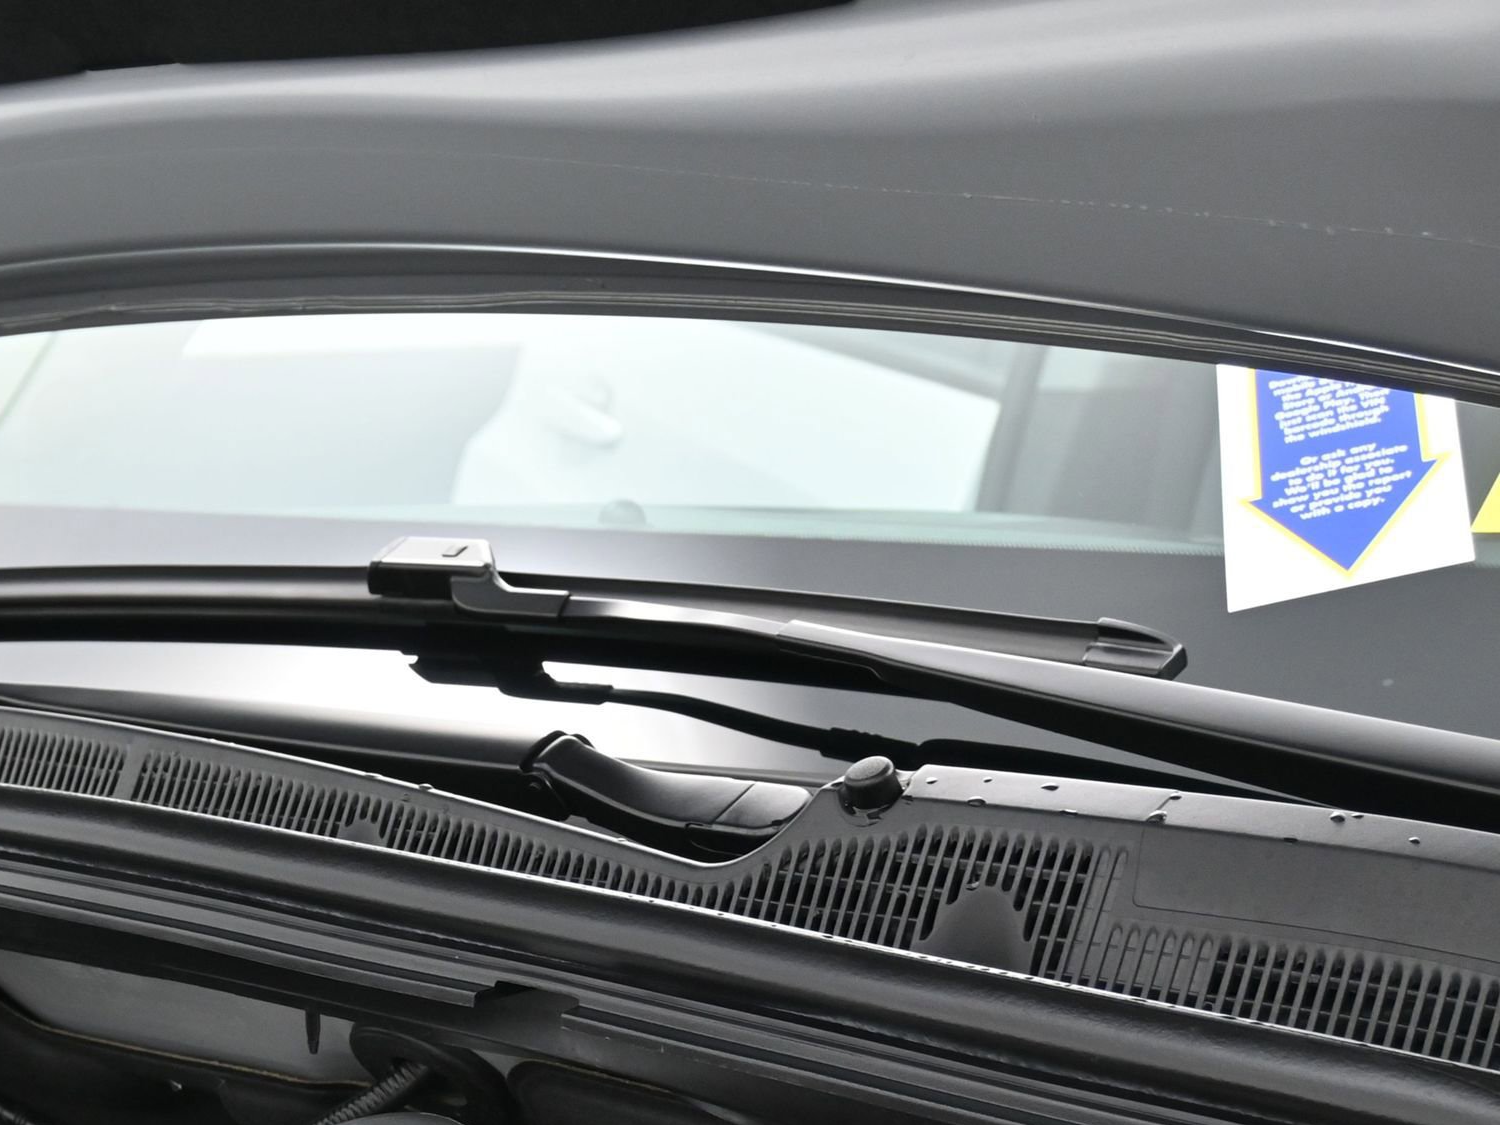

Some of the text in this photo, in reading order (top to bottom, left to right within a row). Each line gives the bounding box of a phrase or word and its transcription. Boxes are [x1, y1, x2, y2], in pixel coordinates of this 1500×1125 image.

[1274, 405, 1320, 420] Google
[1283, 418, 1336, 435] barcode
[1284, 434, 1305, 444] the
[1321, 449, 1347, 461] ask
[1350, 443, 1377, 455] any
[1270, 445, 1408, 482] dealership associate
[1288, 478, 1303, 487] to
[1306, 472, 1324, 483] do
[1327, 468, 1337, 477] it
[1340, 464, 1361, 475] for
[1323, 478, 1341, 488] be
[1344, 469, 1376, 484] glad
[1378, 466, 1394, 475] to
[1272, 470, 1412, 509] show you the report
[1290, 485, 1393, 513] or provide you
[1300, 507, 1331, 520] with
